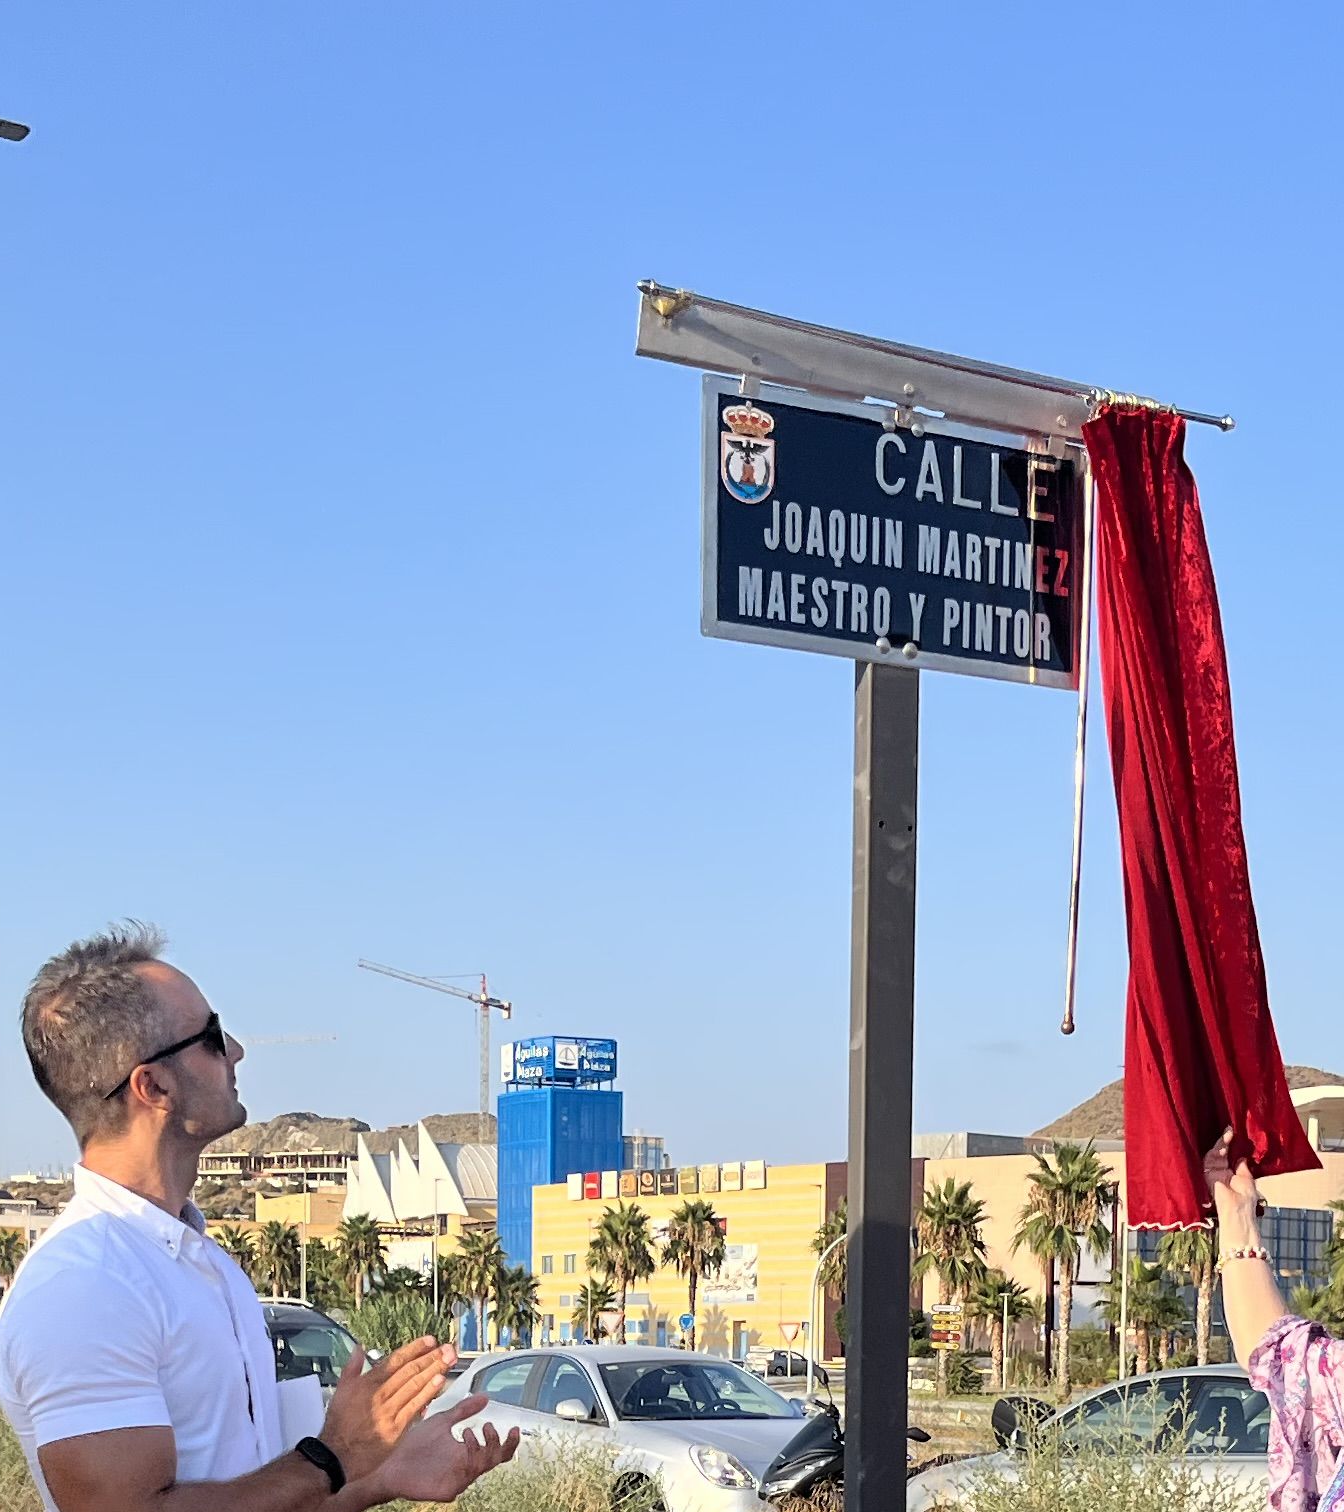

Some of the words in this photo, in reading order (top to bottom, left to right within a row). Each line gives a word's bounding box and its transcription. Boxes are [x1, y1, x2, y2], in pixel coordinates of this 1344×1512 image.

[874, 432, 1056, 523] CALLE
[763, 499, 904, 569] JOAQUIN
[917, 523, 1070, 598] MARTINEZ
[738, 565, 892, 637] MAESTRO
[908, 592, 927, 643] Y
[942, 597, 1052, 662] PINTOR
